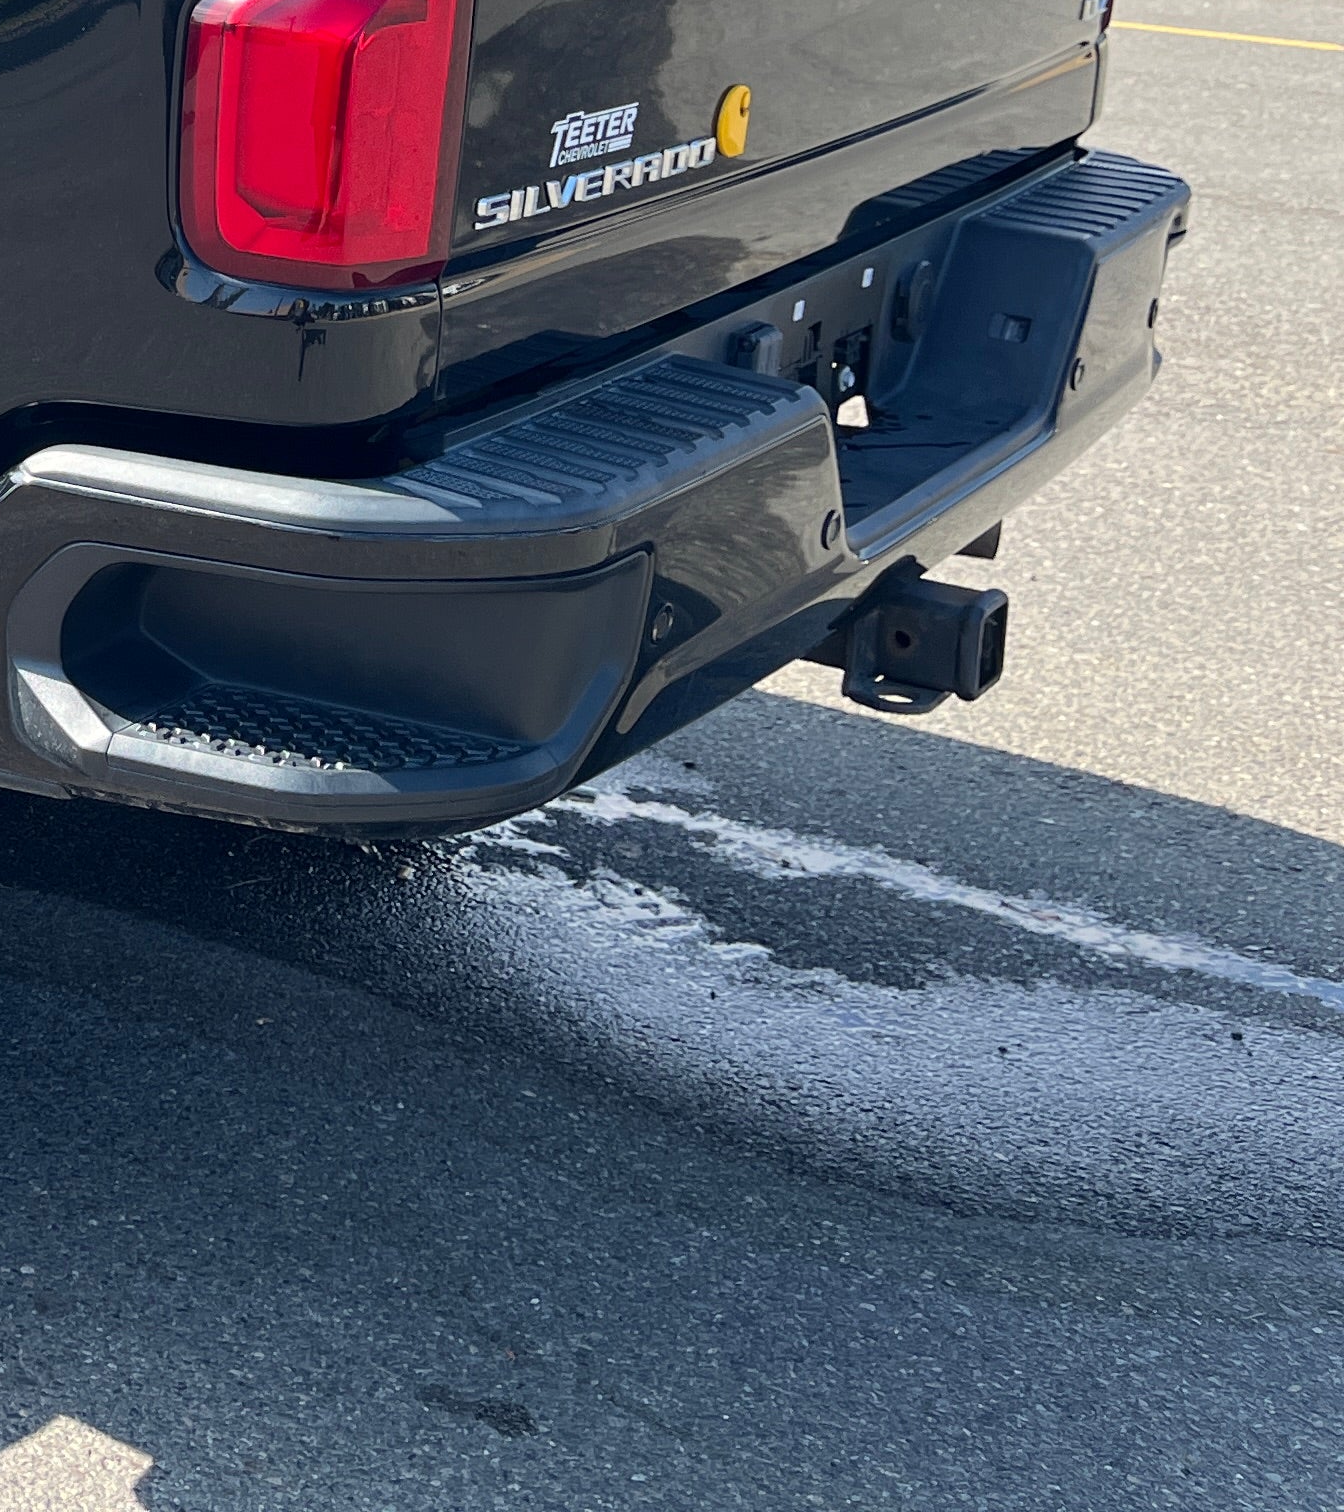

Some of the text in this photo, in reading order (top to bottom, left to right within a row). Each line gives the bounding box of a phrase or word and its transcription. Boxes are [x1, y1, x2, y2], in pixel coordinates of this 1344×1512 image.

[549, 102, 639, 168] TEETER
[558, 139, 609, 166] CHEVROLET
[474, 137, 716, 231] SILVERADO
